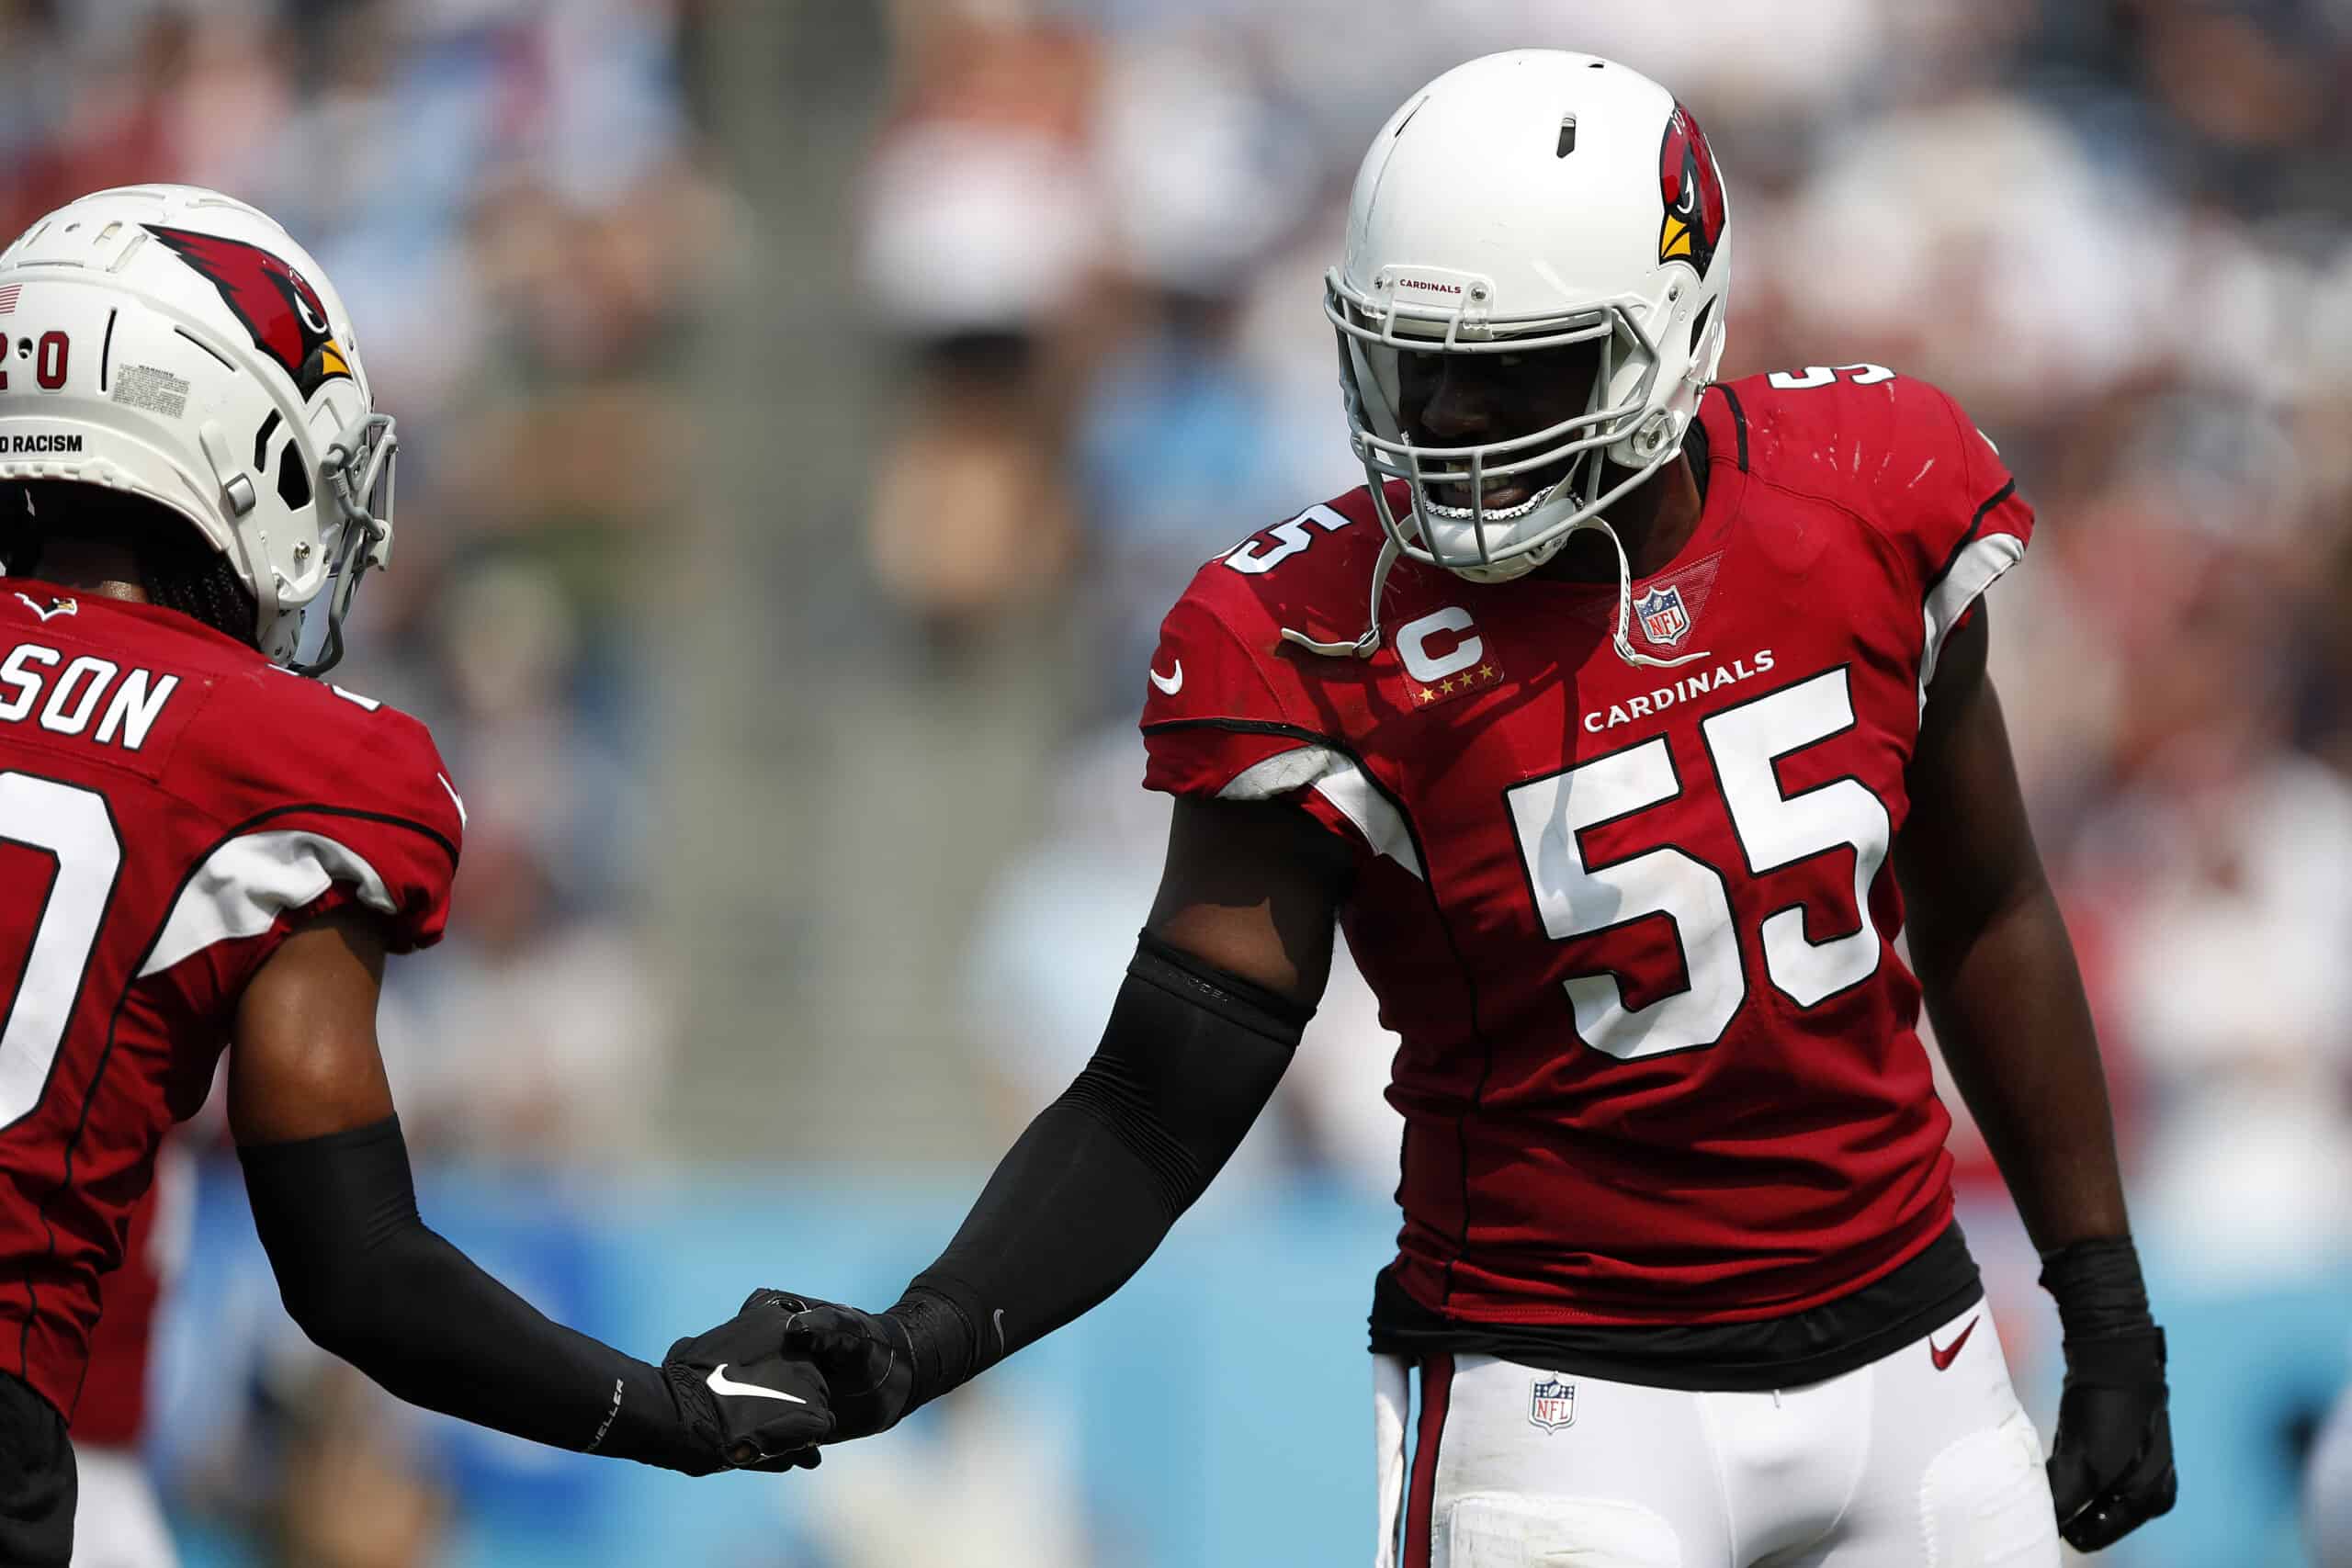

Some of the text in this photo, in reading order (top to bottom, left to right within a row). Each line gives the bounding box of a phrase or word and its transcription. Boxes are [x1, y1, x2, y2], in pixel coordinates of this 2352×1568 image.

[1399, 278, 1462, 294] CARDINALS
[0, 331, 70, 389] 0
[13, 434, 83, 453] RACISM
[1396, 605, 1484, 683] C
[1648, 610, 1682, 636] NFL
[1583, 649, 1775, 734] CARDINALS
[1504, 661, 1891, 1065] 55
[1536, 1399, 1568, 1422] NFL
